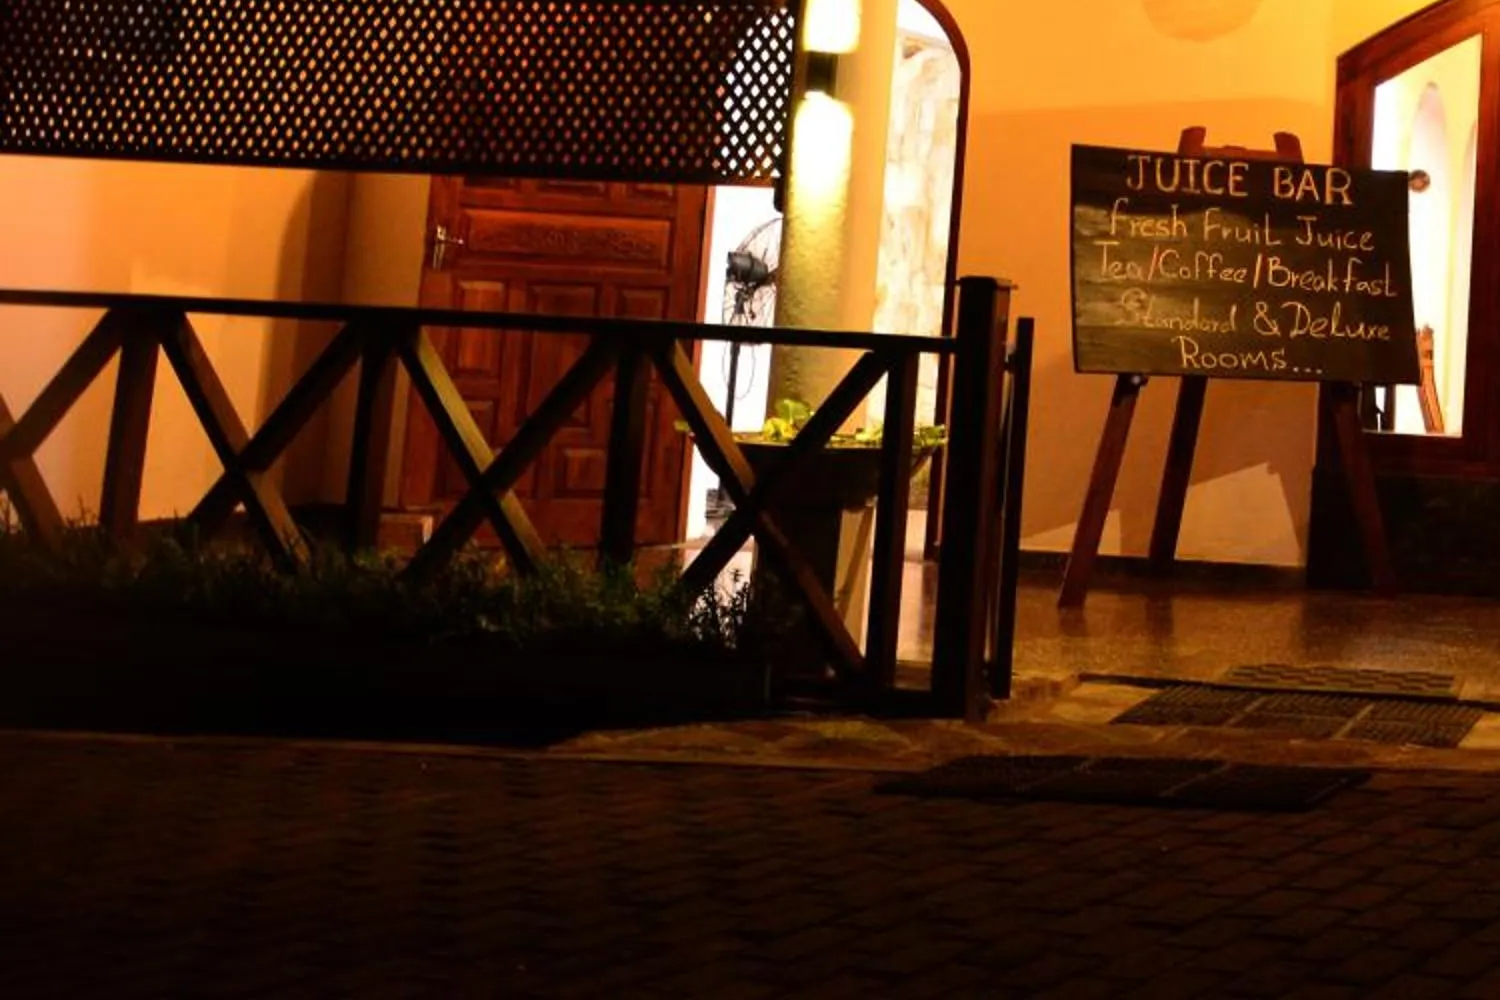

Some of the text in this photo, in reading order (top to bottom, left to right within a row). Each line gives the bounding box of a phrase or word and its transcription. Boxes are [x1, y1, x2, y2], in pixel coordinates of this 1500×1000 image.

[1126, 155, 1353, 206] JUICE BAR
[1203, 207, 1281, 247] Fruit
[1295, 214, 1375, 252] Juice
[1115, 287, 1391, 341] Standard & Deluxe
